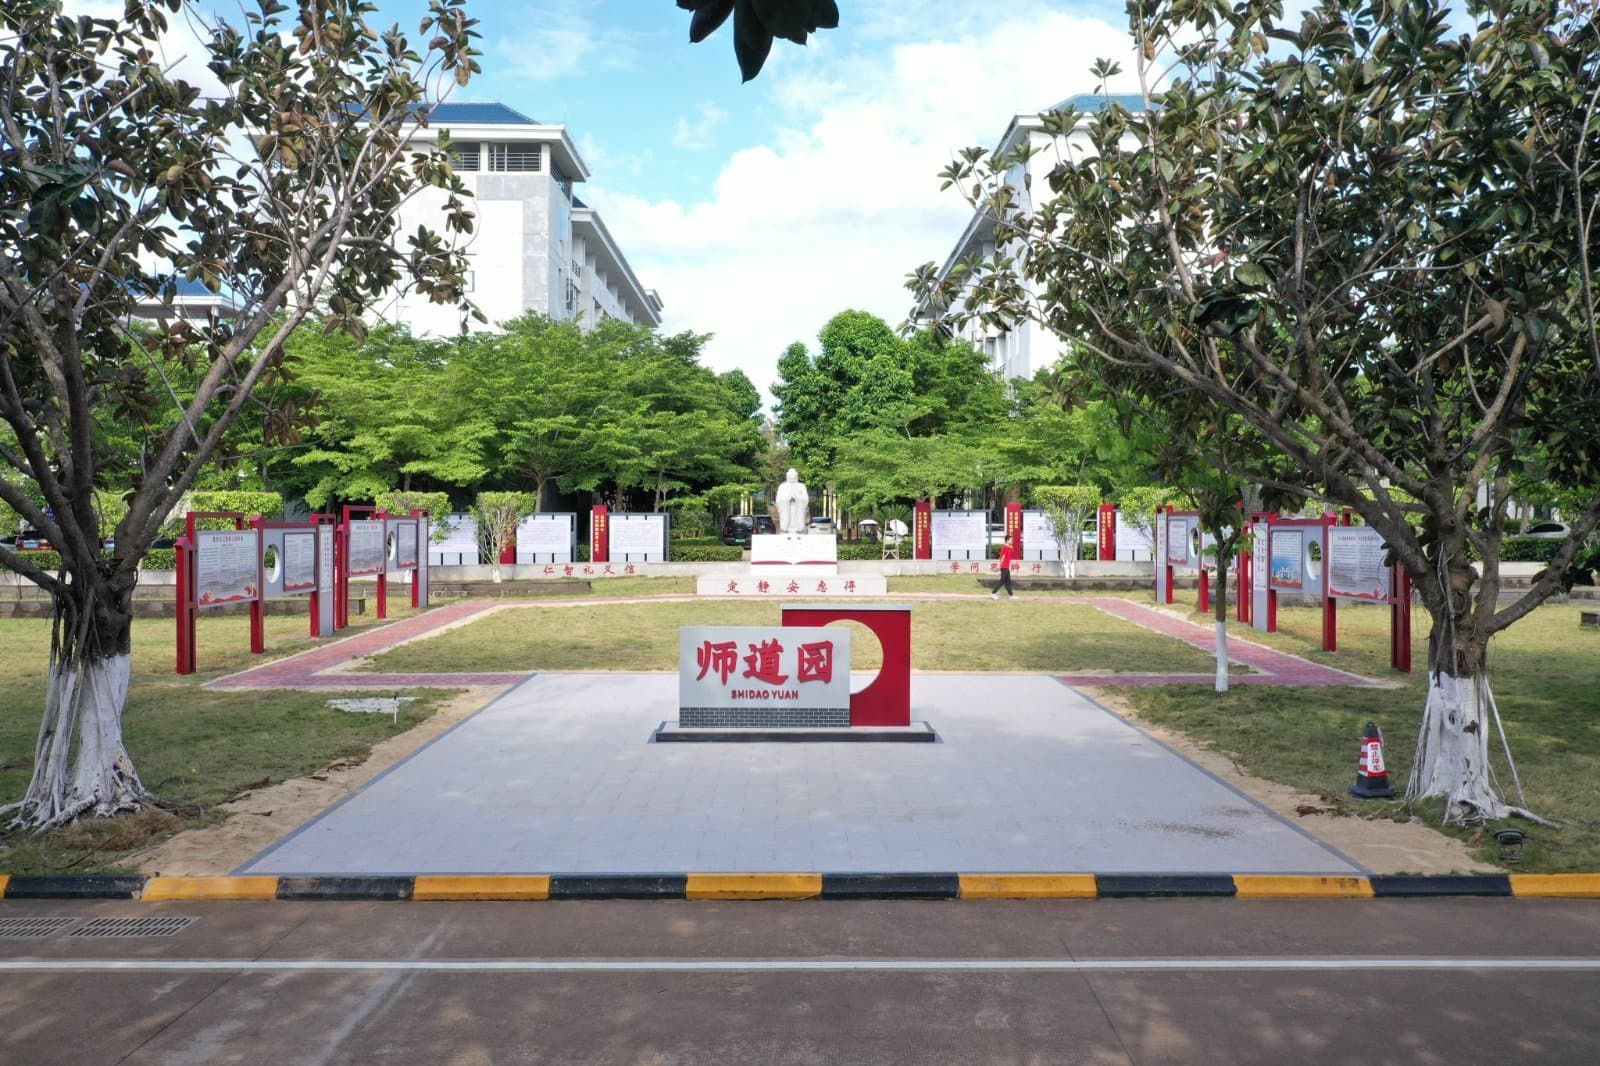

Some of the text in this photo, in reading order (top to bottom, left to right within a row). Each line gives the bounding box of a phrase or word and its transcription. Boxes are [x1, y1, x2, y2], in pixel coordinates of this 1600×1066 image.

[543, 563, 636, 576] 仁智礼义信
[727, 579, 857, 593] 定静安虑得
[696, 637, 834, 685] 师道园
[731, 689, 799, 700] SHIDAO YUAN
